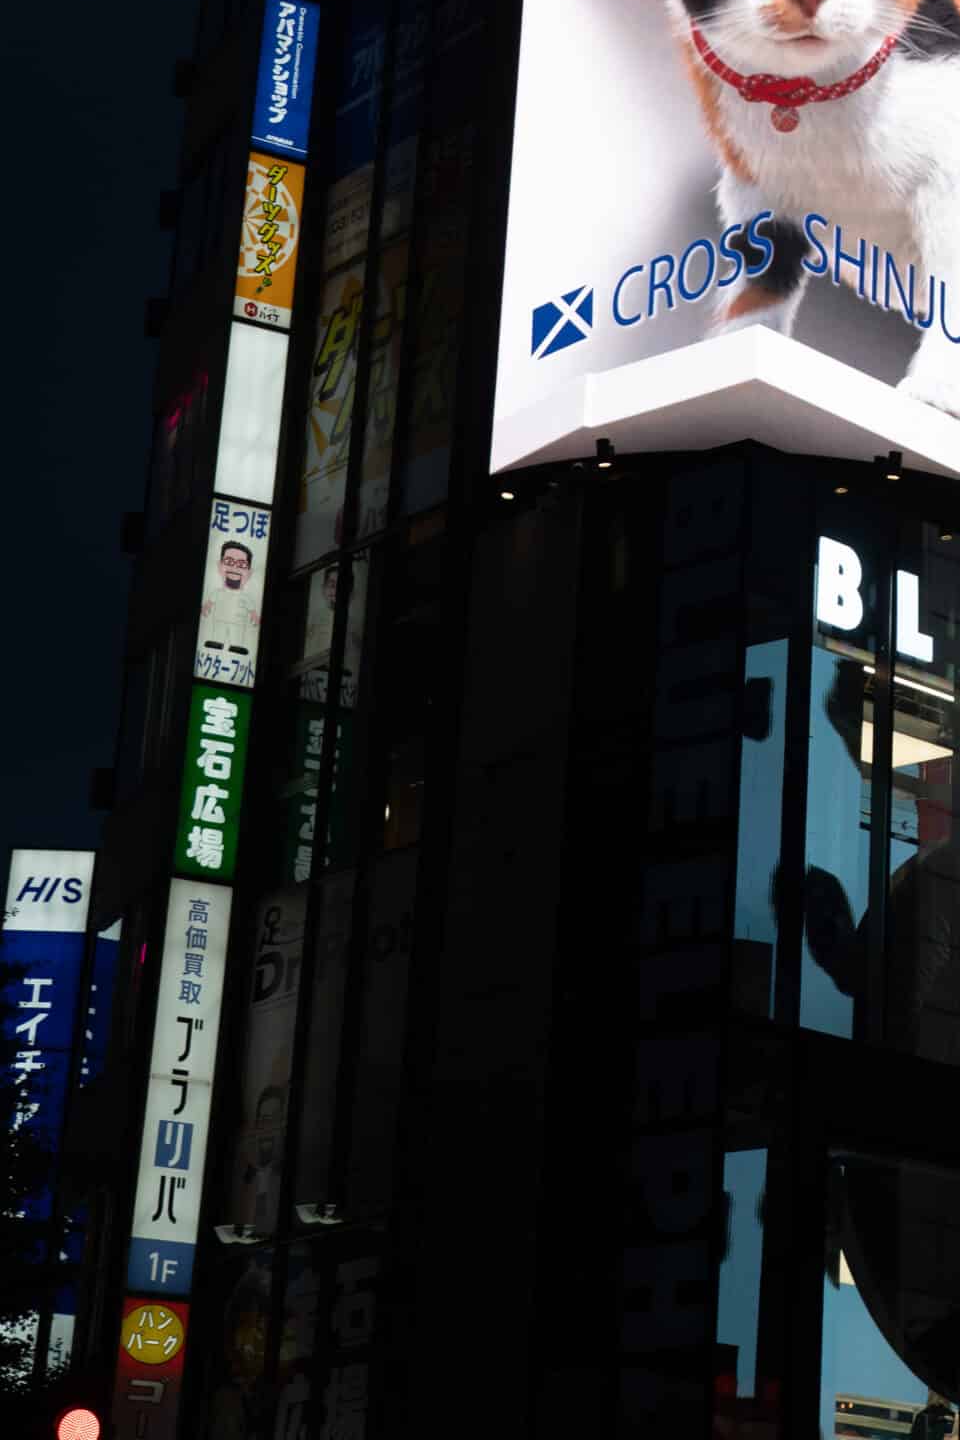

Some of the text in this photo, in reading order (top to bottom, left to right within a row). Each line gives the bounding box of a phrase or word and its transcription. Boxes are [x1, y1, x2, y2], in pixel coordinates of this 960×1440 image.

[267, 0, 297, 125] アパマンショップ
[612, 210, 774, 327] CROSS
[211, 502, 269, 538] 足つぼ
[184, 695, 239, 871] 宝石広場
[17, 877, 82, 904] HIS
[178, 898, 211, 1005] 高価買取
[151, 1016, 204, 1223] ブラリバ
[138, 1311, 173, 1330] ハン
[148, 1251, 178, 1285] 1F
